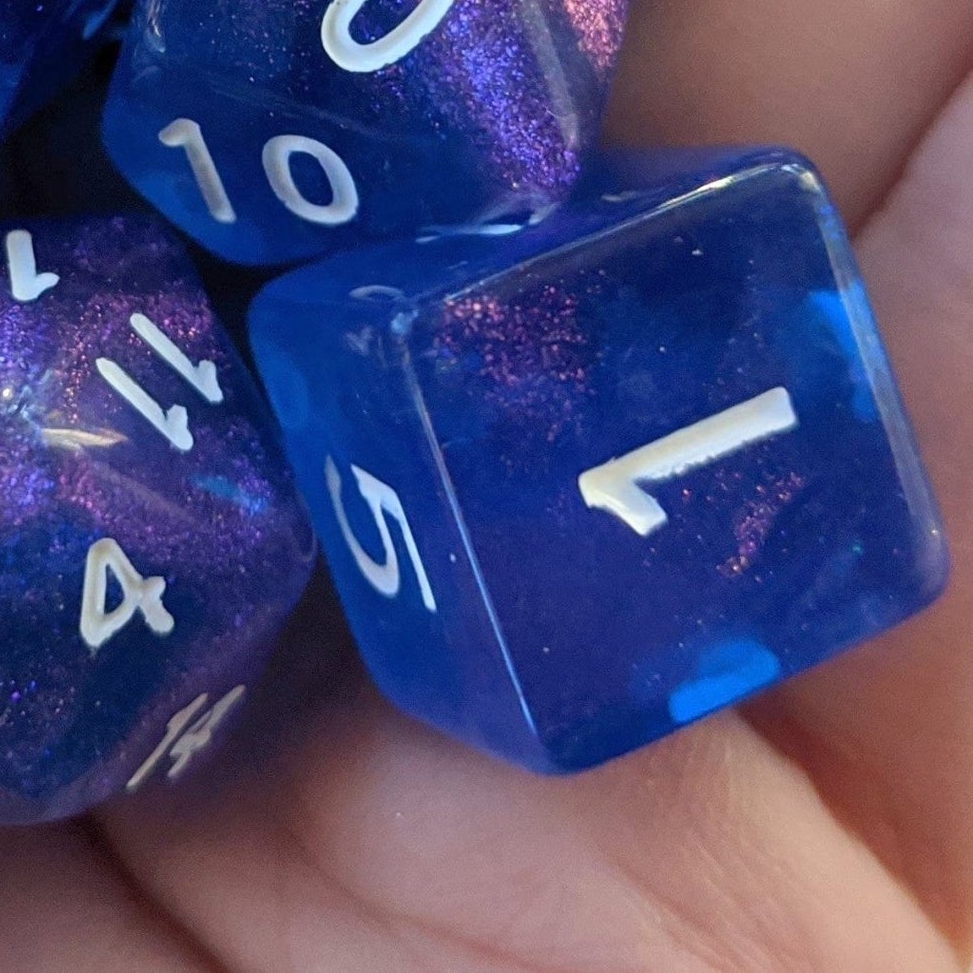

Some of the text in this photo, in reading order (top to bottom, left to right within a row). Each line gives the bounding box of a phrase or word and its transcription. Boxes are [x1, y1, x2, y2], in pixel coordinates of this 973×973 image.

[158, 118, 360, 225] 10
[95, 313, 224, 451] 11
[578, 387, 798, 537] 1
[79, 537, 175, 650] 4
[324, 454, 437, 614] 5
